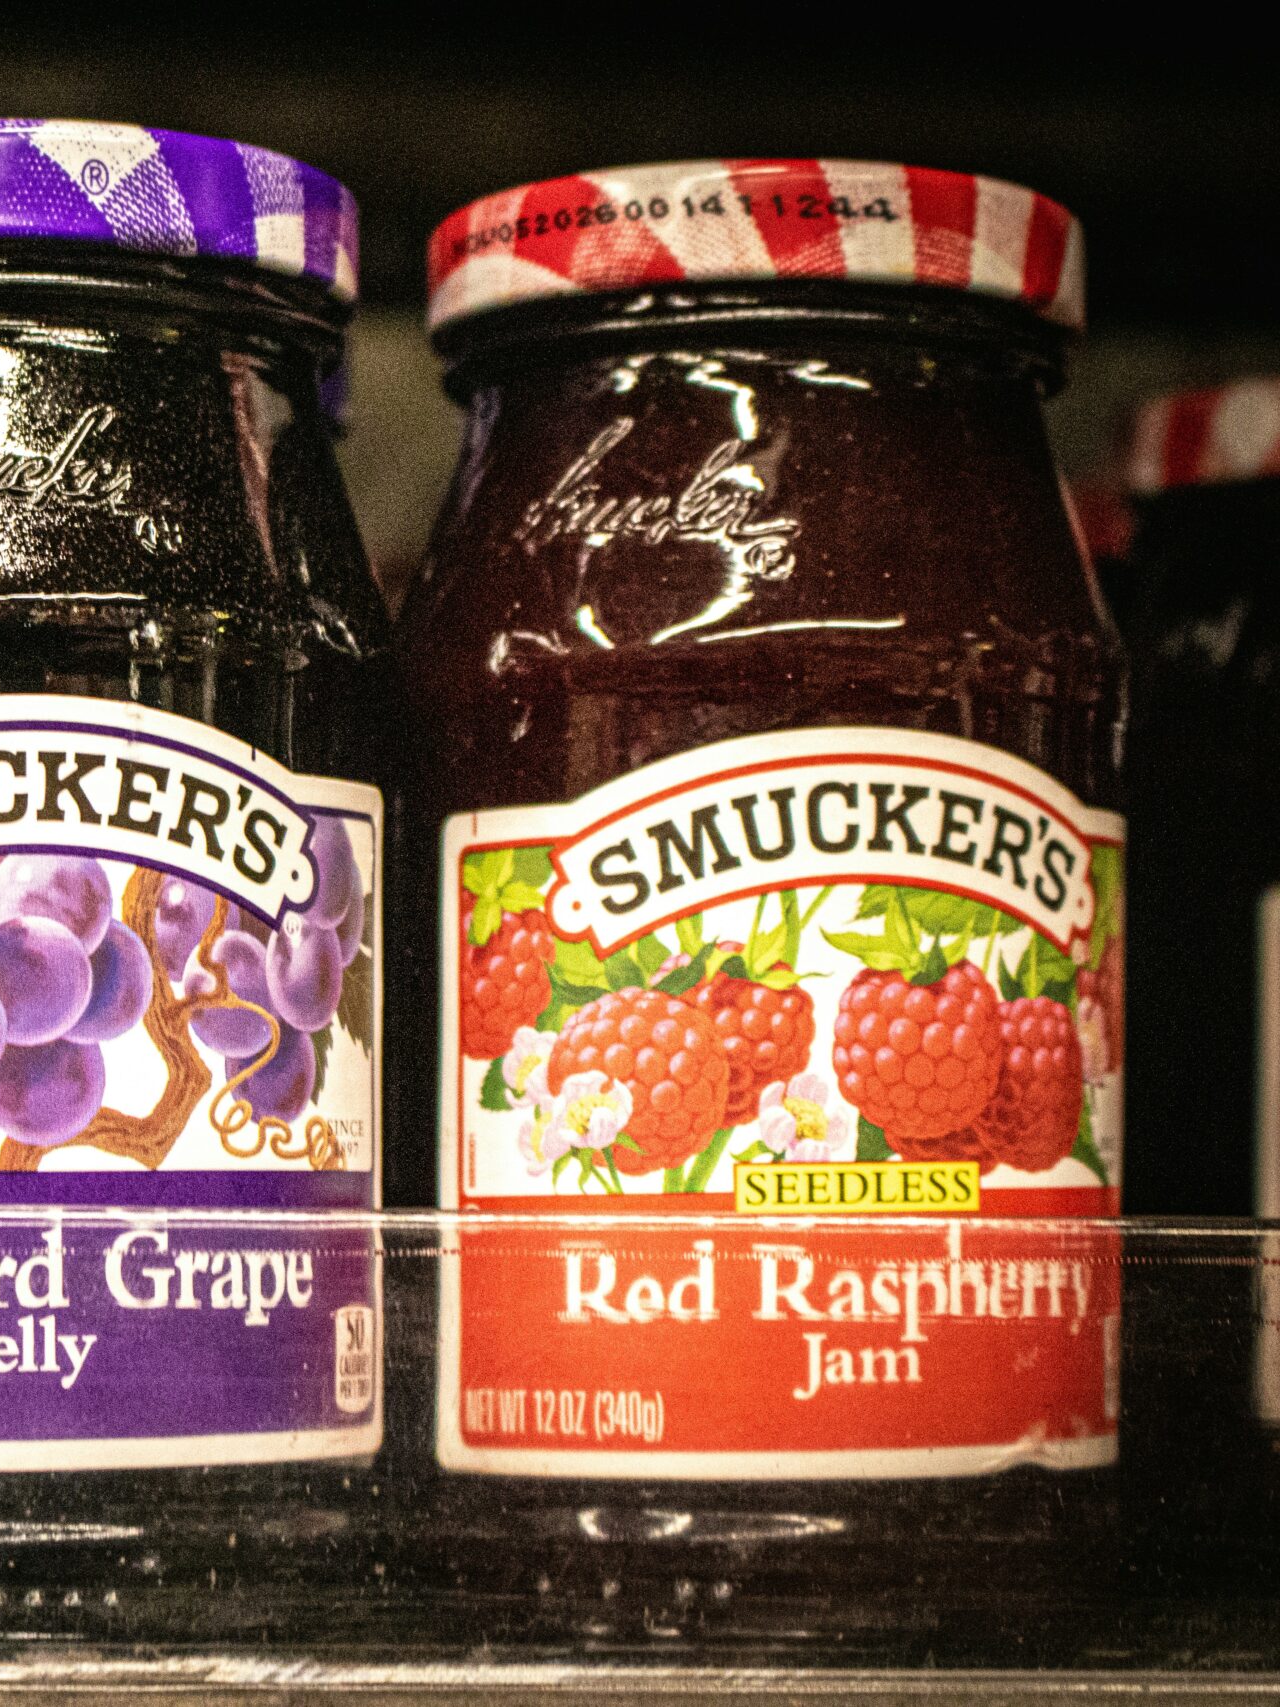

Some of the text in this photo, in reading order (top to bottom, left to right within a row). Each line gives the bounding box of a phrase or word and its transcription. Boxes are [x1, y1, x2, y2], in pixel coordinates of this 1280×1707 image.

[588, 781, 1077, 915] SMUCKER'S
[743, 1168, 974, 1207] SEEDLESS
[104, 1229, 314, 1326] Grape
[558, 1239, 720, 1324] Red
[792, 1332, 922, 1400] Jam
[465, 1388, 665, 1443] NET WT 12 OZ (340g)
